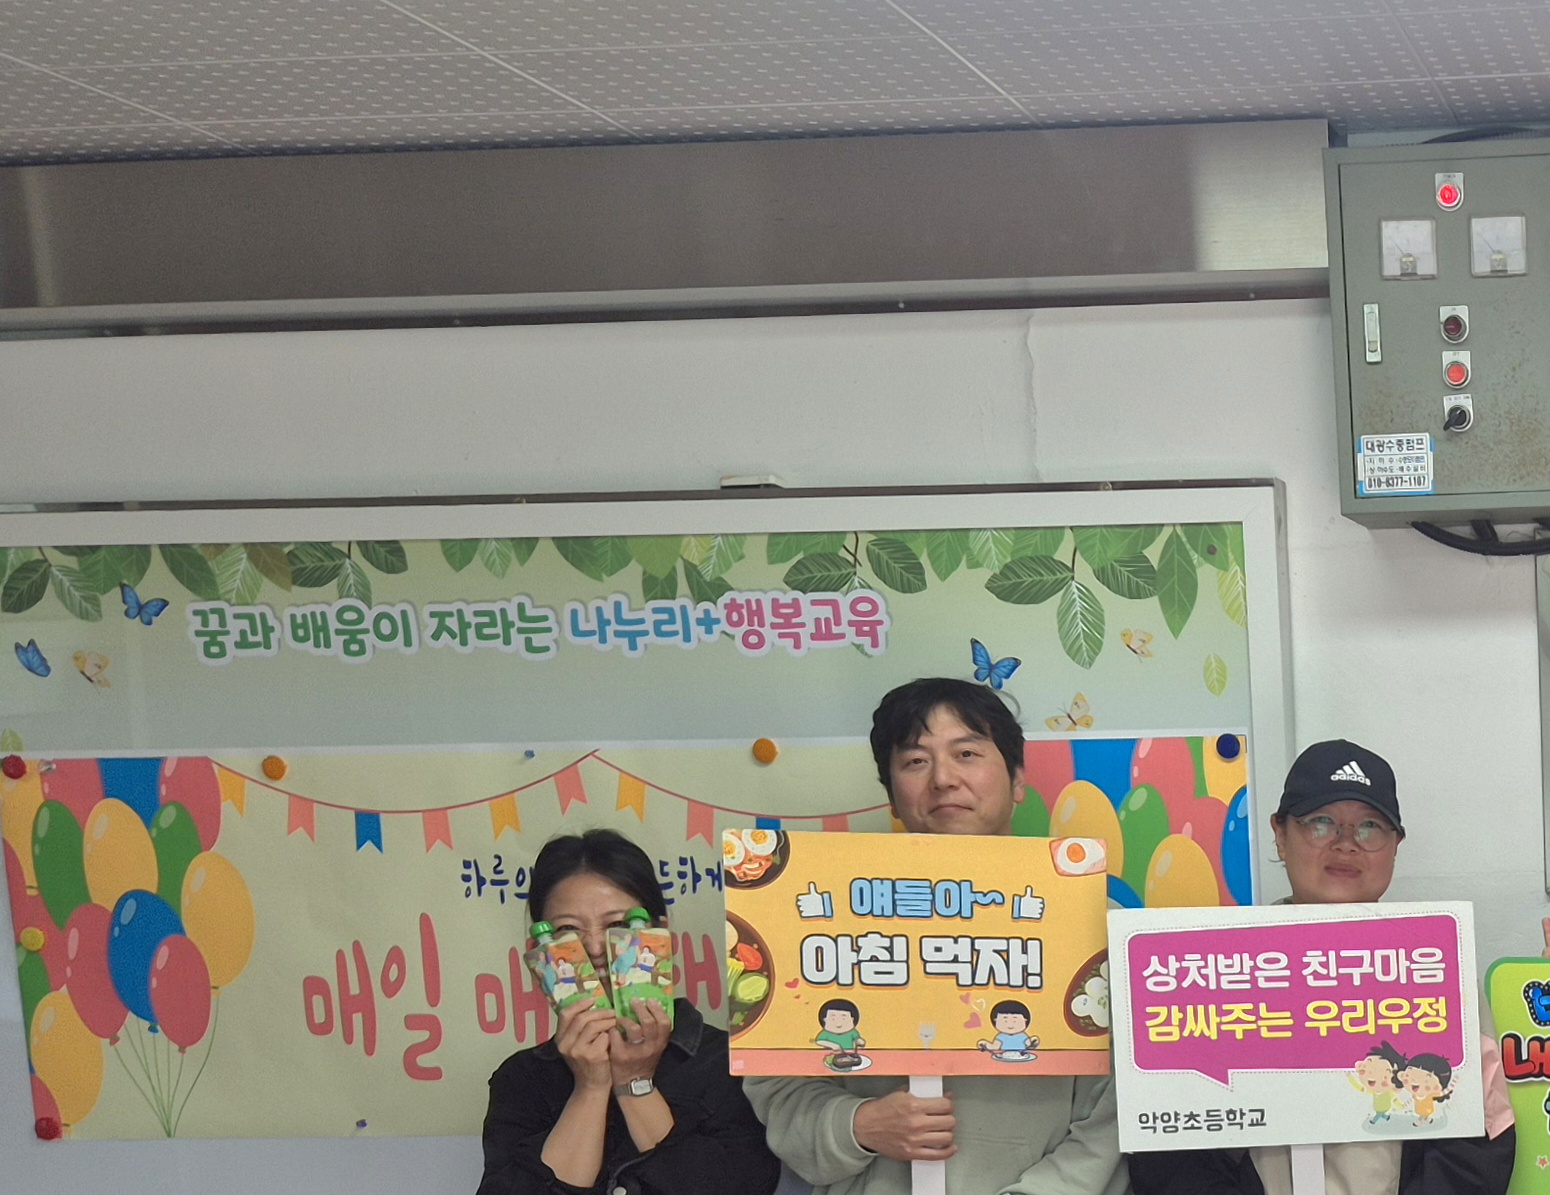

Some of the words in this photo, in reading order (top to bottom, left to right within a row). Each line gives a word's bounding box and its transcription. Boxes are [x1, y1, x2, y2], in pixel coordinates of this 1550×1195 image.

[193, 605, 276, 659] 꿈과
[290, 604, 413, 657] 배움이
[430, 603, 554, 654] 자라는
[1330, 774, 1371, 786] adidas
[800, 931, 910, 987] 아침
[919, 935, 1044, 990] 먹자!
[1142, 950, 1291, 993] 상처받은
[1301, 947, 1446, 988] 친구마음
[303, 912, 442, 1081] 매일
[1144, 1002, 1294, 1042] 감싸주는
[1304, 996, 1448, 1036] 우리우정
[1138, 1108, 1268, 1134] 악양초등학교
